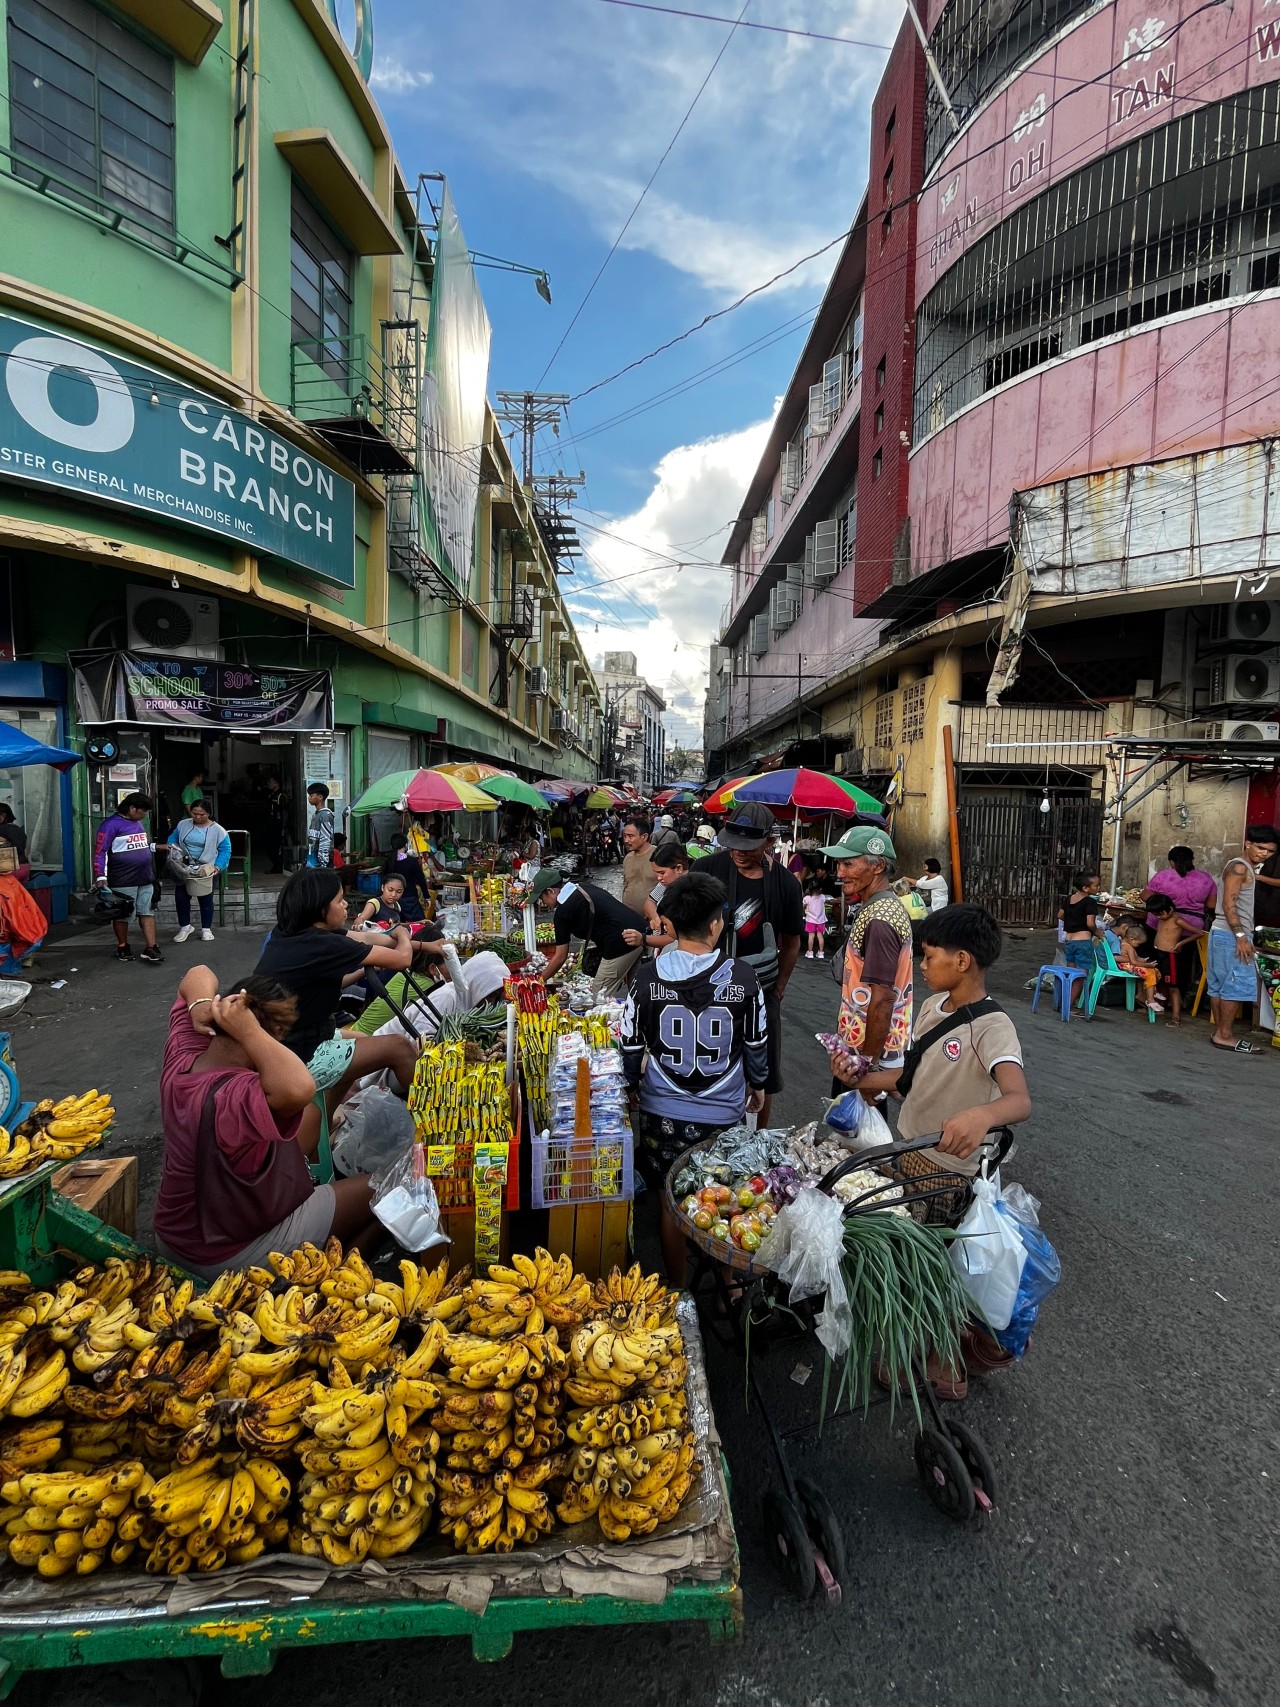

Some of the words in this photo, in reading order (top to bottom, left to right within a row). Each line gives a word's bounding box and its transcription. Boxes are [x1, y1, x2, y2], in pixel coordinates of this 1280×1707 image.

[930, 196, 978, 270] CHAN
[1007, 139, 1047, 195] OH
[1112, 62, 1176, 126] TAN
[6, 337, 135, 452] O
[178, 399, 334, 501] CARBON
[1, 448, 46, 470] STER
[52, 461, 128, 492] GENERAL
[134, 483, 231, 526] MERCHANDISE
[234, 518, 256, 536] INC.
[180, 448, 333, 543] BRANCH
[128, 676, 205, 697] SCHOOL
[146, 701, 179, 710] PROMO
[181, 701, 204, 710] SALE
[163, 662, 180, 676] TO
[224, 671, 253, 689] 30%
[261, 675, 287, 692] 50%
[261, 691, 279, 700] OFF
[659, 1004, 734, 1078] 99
